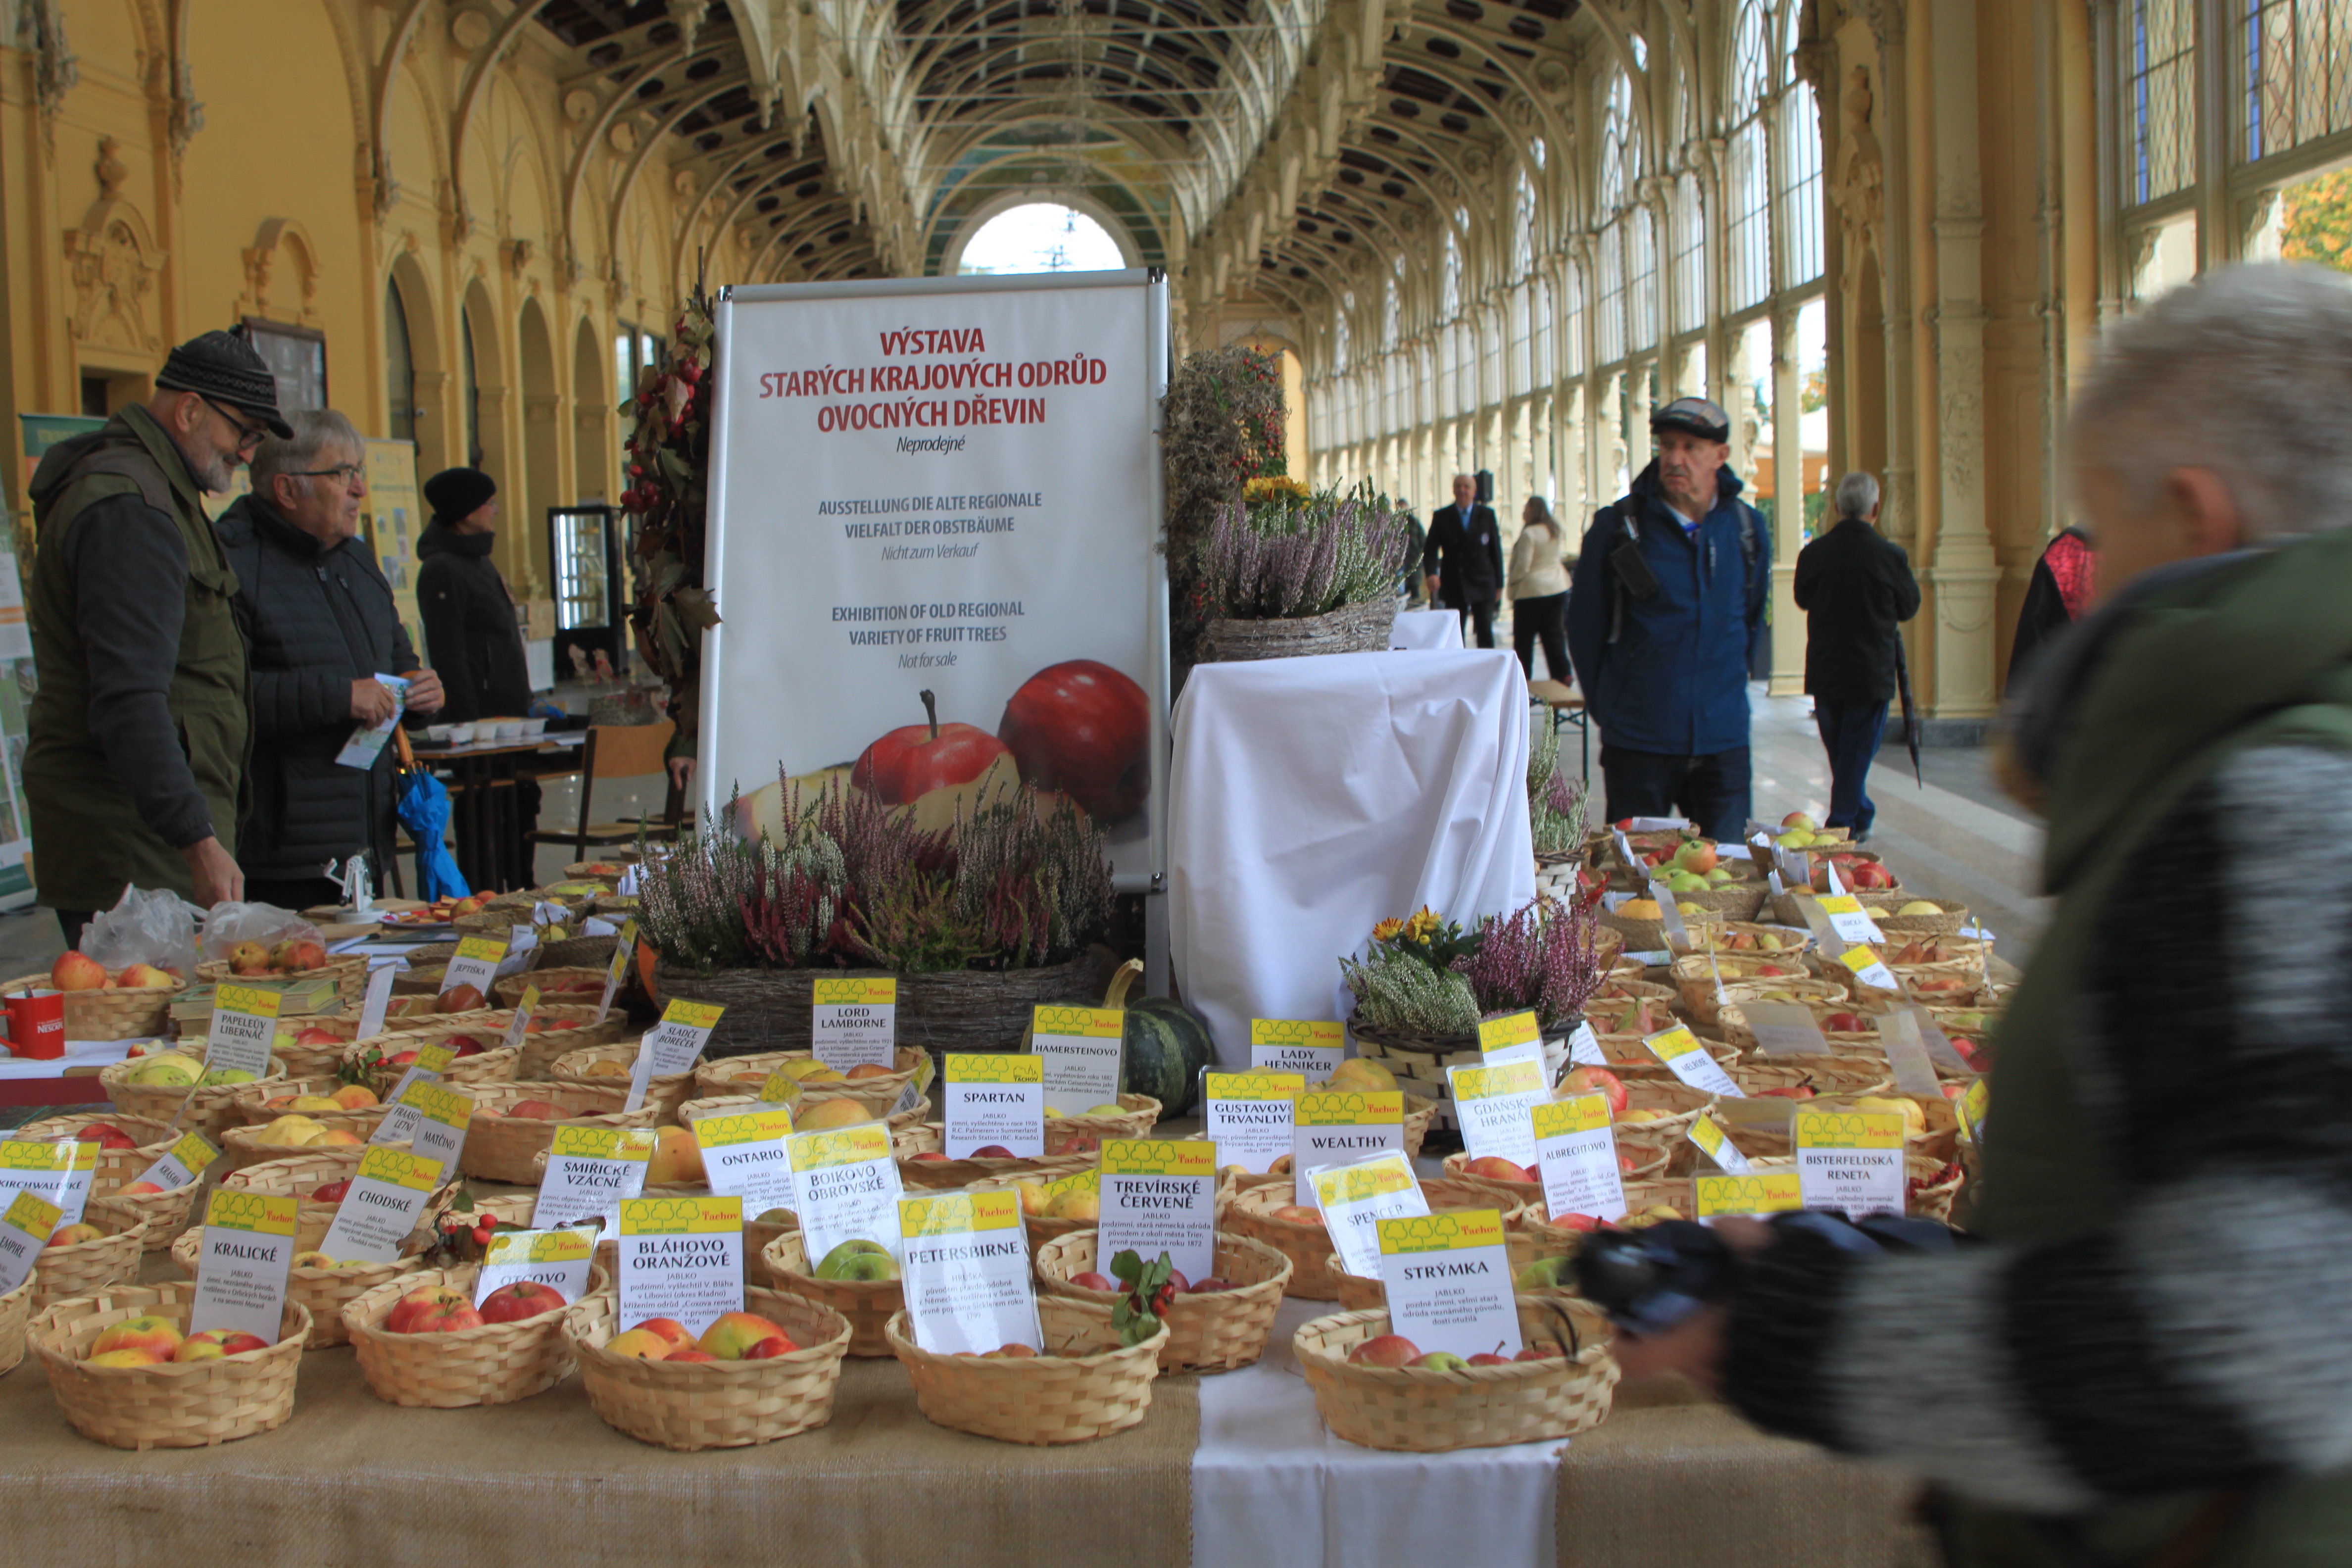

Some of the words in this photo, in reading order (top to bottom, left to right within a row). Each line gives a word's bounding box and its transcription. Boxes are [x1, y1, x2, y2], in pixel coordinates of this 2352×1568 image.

[880, 326, 985, 356] VÝSTAVA
[759, 365, 864, 398] STARÝCH
[871, 358, 1012, 392] KRAJOVÝCH
[1017, 352, 1107, 388] ODRŮD
[818, 396, 947, 432] OVOCNÝCH
[954, 394, 1045, 427] DŘEVIN
[897, 435, 965, 455] Neprodejné
[818, 496, 909, 515] AUSSTELLUNG
[912, 496, 933, 511] DIE
[935, 495, 966, 510] ALTE
[968, 493, 1042, 509] REGIONALE
[845, 521, 902, 539] VIELFALT
[904, 520, 930, 536] DER
[932, 515, 1014, 534] OBSTBÄUME
[882, 545, 909, 561] Nicht
[910, 546, 934, 559] zum
[936, 542, 979, 559] Verkauf
[832, 605, 907, 621] EXHIBITION
[910, 604, 927, 619] OF
[929, 603, 955, 618] OLD
[958, 601, 1025, 618] REGIONAL
[849, 629, 904, 645] VARIETY
[906, 629, 923, 643] OF
[926, 627, 965, 642] FRUIT
[967, 626, 1007, 641] TREES
[898, 653, 918, 669] Not
[919, 653, 934, 667] for
[934, 652, 957, 666] sale
[454, 964, 485, 976] JEPTIŠKA
[838, 1009, 869, 1017] LORD
[822, 1019, 886, 1029] LAMBORNE
[658, 1035, 696, 1048] BOREČEK
[1036, 1044, 1117, 1056] HAMERSTEINOVO
[1281, 1050, 1315, 1059] LADY
[1265, 1060, 1331, 1071] HENNIKER
[1681, 1058, 1708, 1072] MELROSE
[964, 1093, 1024, 1103] SPARTAN
[394, 1108, 420, 1122] FRAASO
[1368, 1104, 1399, 1113] Tachov
[1219, 1113, 1293, 1124] TRVANLIVÉ
[394, 1120, 414, 1132] LETNÍ
[760, 1123, 787, 1131] Tachov
[1867, 1127, 1899, 1136] Tachov
[424, 1131, 455, 1150] MATČINO
[854, 1140, 883, 1150] Tachov
[1312, 1136, 1386, 1148] WEALTHY
[1546, 1141, 1606, 1161] ALBRECHTOVO
[723, 1150, 783, 1166] ONTARIO
[1178, 1154, 1212, 1164] Tachov
[1807, 1155, 1893, 1165] BISTERFELDSKÁ
[412, 1168, 435, 1181] Tachov
[564, 1162, 631, 1176] SMIŘICKÉ
[1828, 1171, 1870, 1180] RENETA
[567, 1175, 622, 1188] VZÁCNÉ
[811, 1166, 876, 1186] BOIKOVO
[808, 1176, 885, 1201] OBROVSKÉ
[1114, 1179, 1200, 1194] TREVÍRSKÉ
[1766, 1189, 1797, 1199] Tachov
[359, 1190, 412, 1212] CHODSKÉ
[1121, 1193, 1193, 1209] ČERVENÉ
[267, 1210, 294, 1223] Tachov
[702, 1210, 738, 1221] Tachov
[978, 1207, 1013, 1218] Tachov
[1347, 1204, 1404, 1227] SPENCER
[366, 1215, 386, 1224] JABLKO
[1461, 1225, 1498, 1236] Tachov
[0, 1236, 26, 1258] EMPIRE
[214, 1242, 278, 1262] KRALICKÉ
[639, 1238, 724, 1254] BLÁHOVO
[909, 1241, 1019, 1264] PETERSBIRNE
[633, 1252, 730, 1269] ORANŽOVÉ
[231, 1270, 252, 1278] JABLKO
[1404, 1261, 1489, 1280] STRÝMKA
[669, 1282, 702, 1290] vyšlechtil
[1435, 1288, 1465, 1298] JABLKO
[1406, 1301, 1431, 1310] pozdně
[1431, 1307, 1472, 1316] neznámého
[1475, 1304, 1504, 1313] původu,
[690, 1309, 718, 1317] prvními
